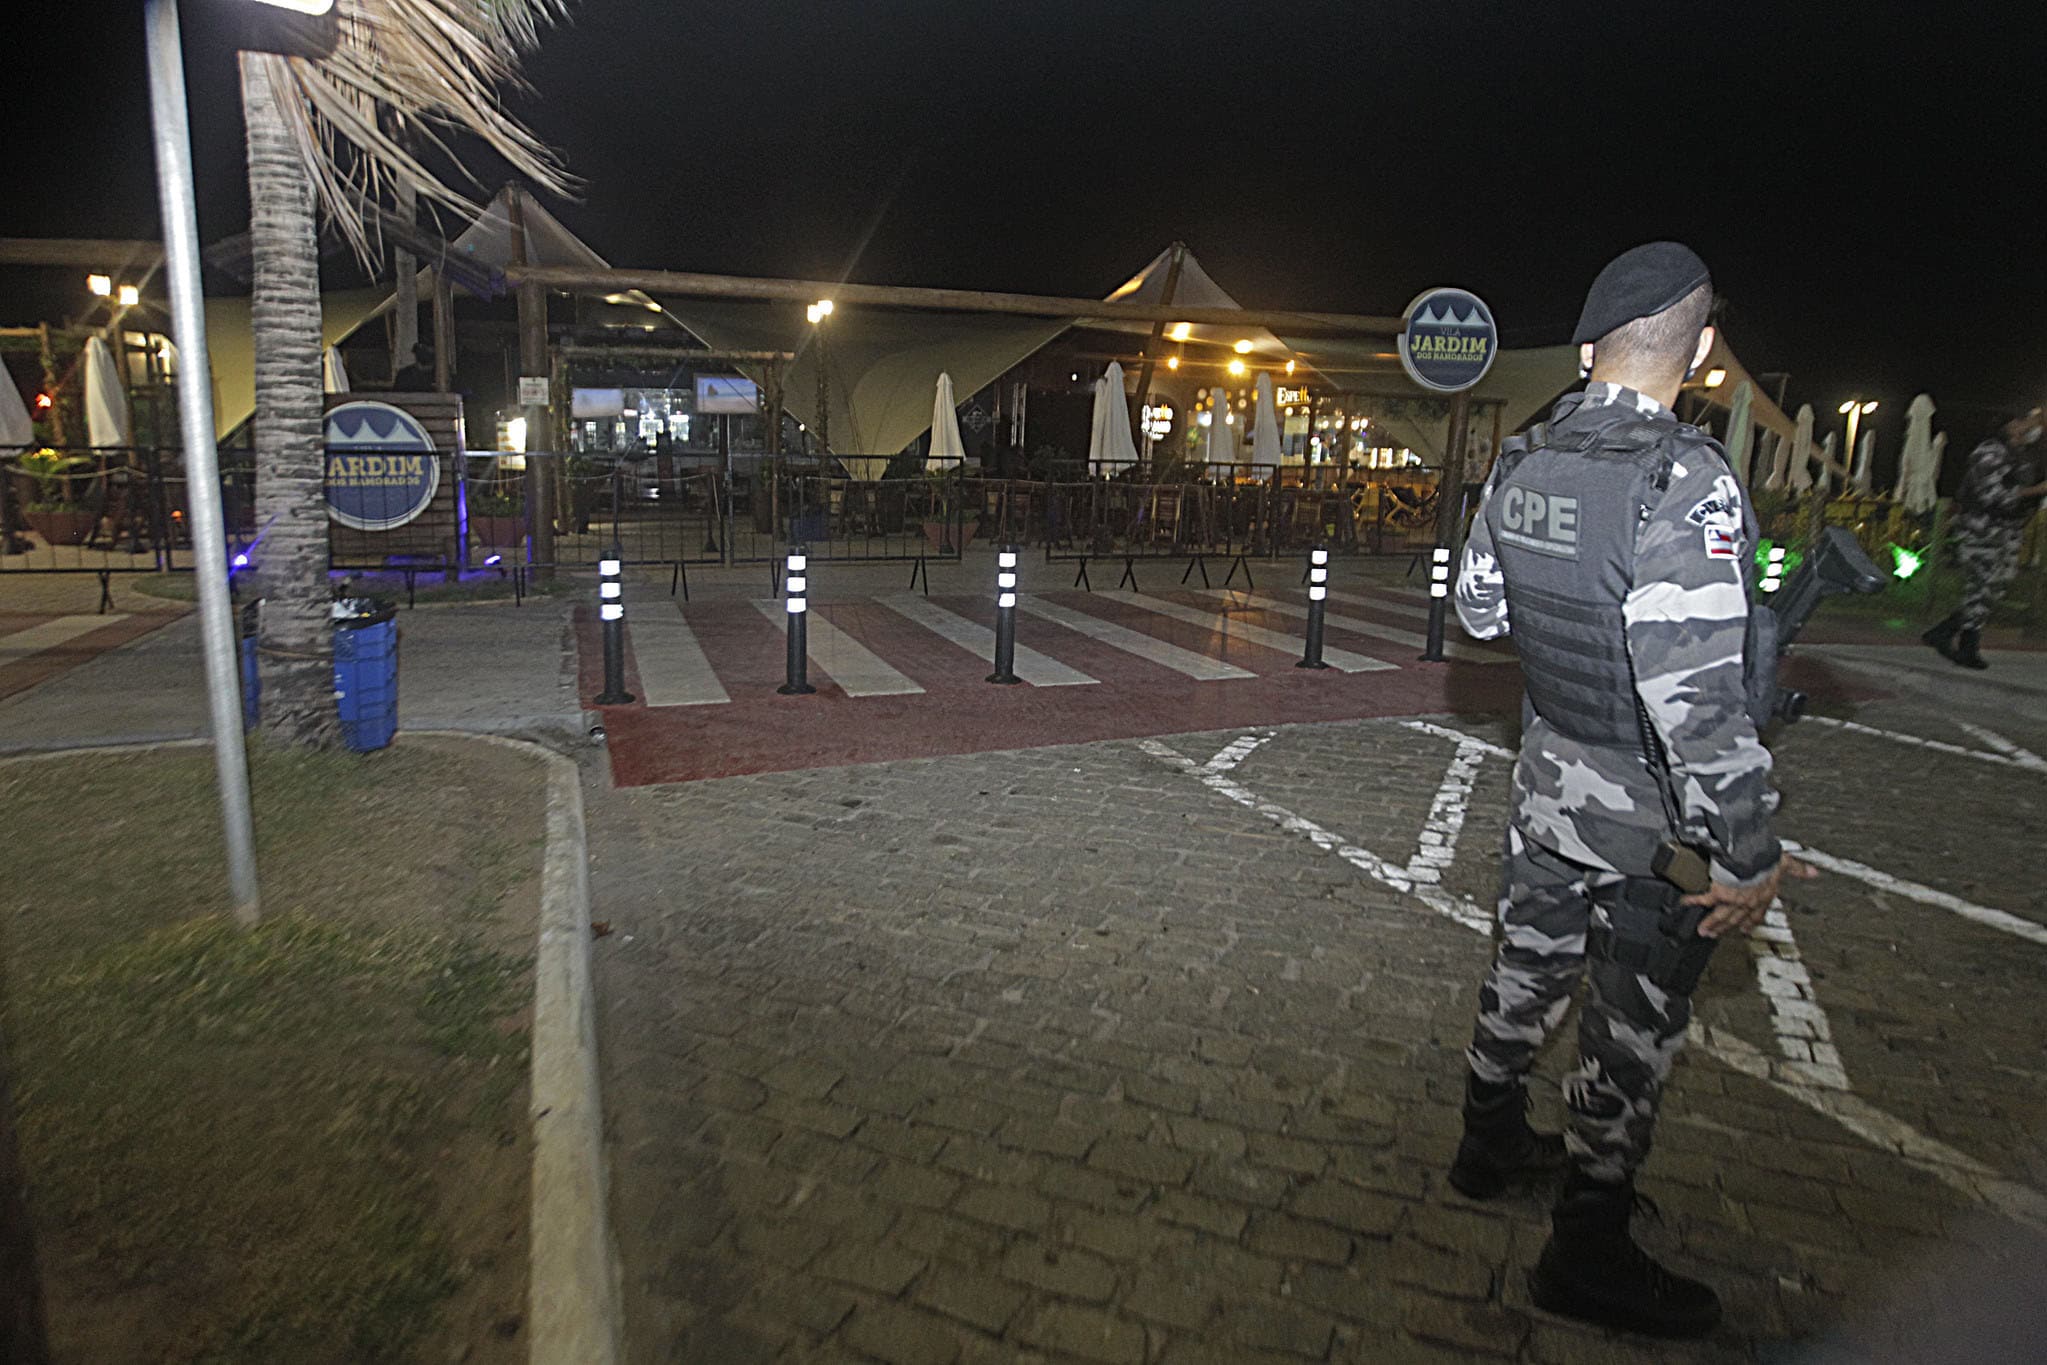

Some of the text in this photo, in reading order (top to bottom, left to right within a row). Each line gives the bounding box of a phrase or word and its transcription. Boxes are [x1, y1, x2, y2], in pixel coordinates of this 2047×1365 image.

[1440, 327, 1461, 336] VILA
[1410, 334, 1488, 354] JARDIM
[1416, 351, 1484, 362] DOS NAMORADOS
[327, 455, 424, 477] ARDIM
[1502, 486, 1578, 543] CPE
